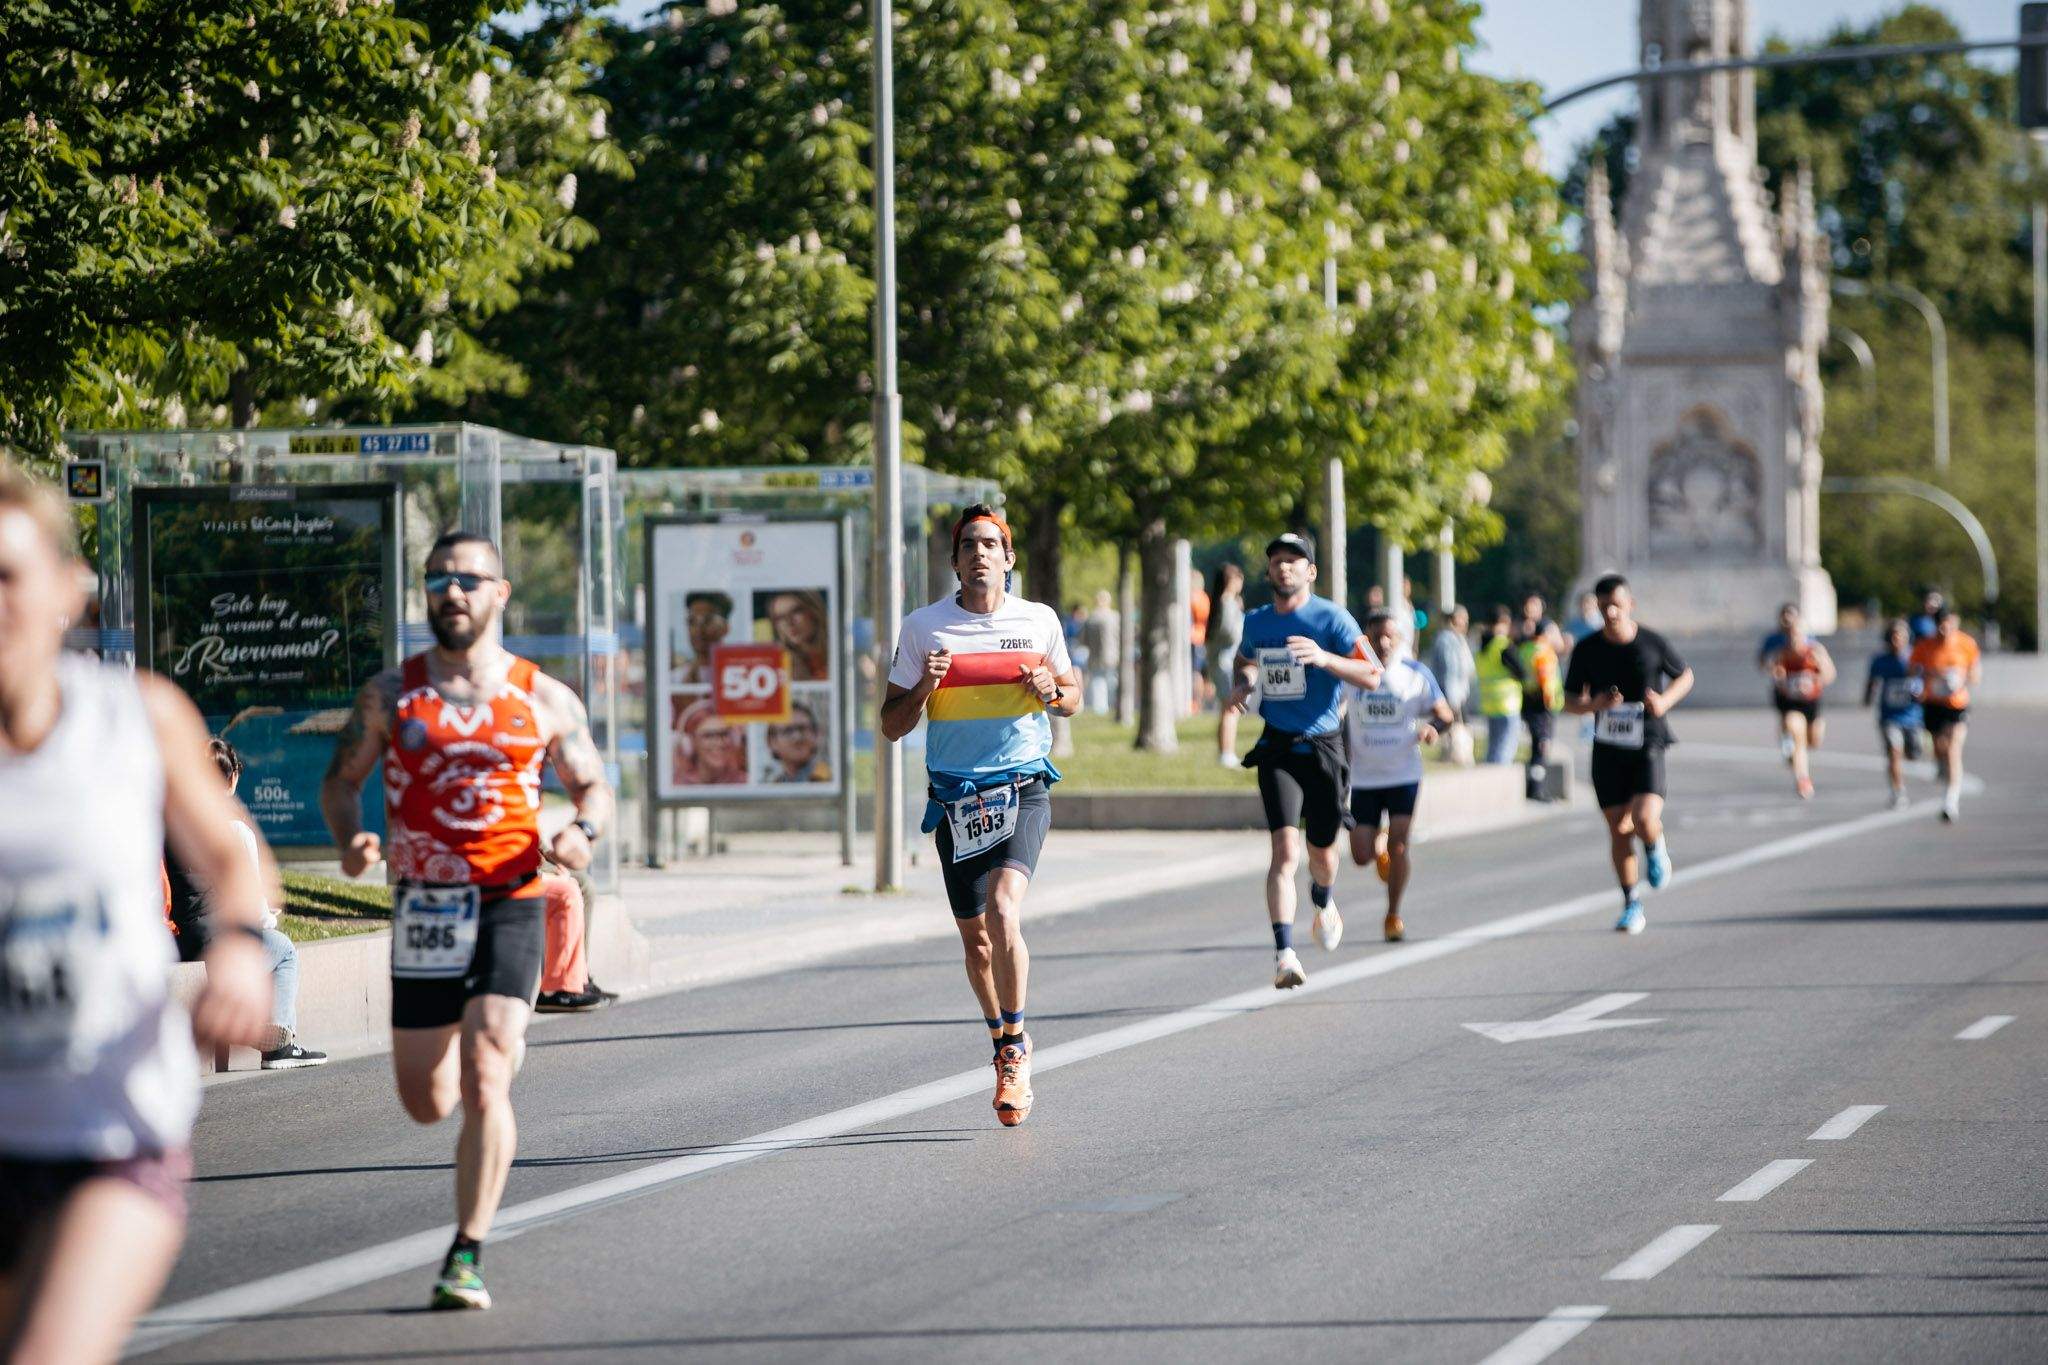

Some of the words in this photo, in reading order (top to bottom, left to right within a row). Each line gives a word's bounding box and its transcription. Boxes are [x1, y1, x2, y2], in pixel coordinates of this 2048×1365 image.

[364, 436, 380, 449] 45
[411, 434, 425, 448] 14
[202, 521, 248, 533] VIAJES
[210, 592, 254, 617] Solo
[259, 593, 288, 618] hay
[200, 622, 220, 635] un
[226, 619, 274, 634] verano
[279, 611, 299, 631] al
[1000, 638, 1033, 650] 226ERS
[1267, 668, 1291, 685] 564
[964, 812, 1005, 841] 1593
